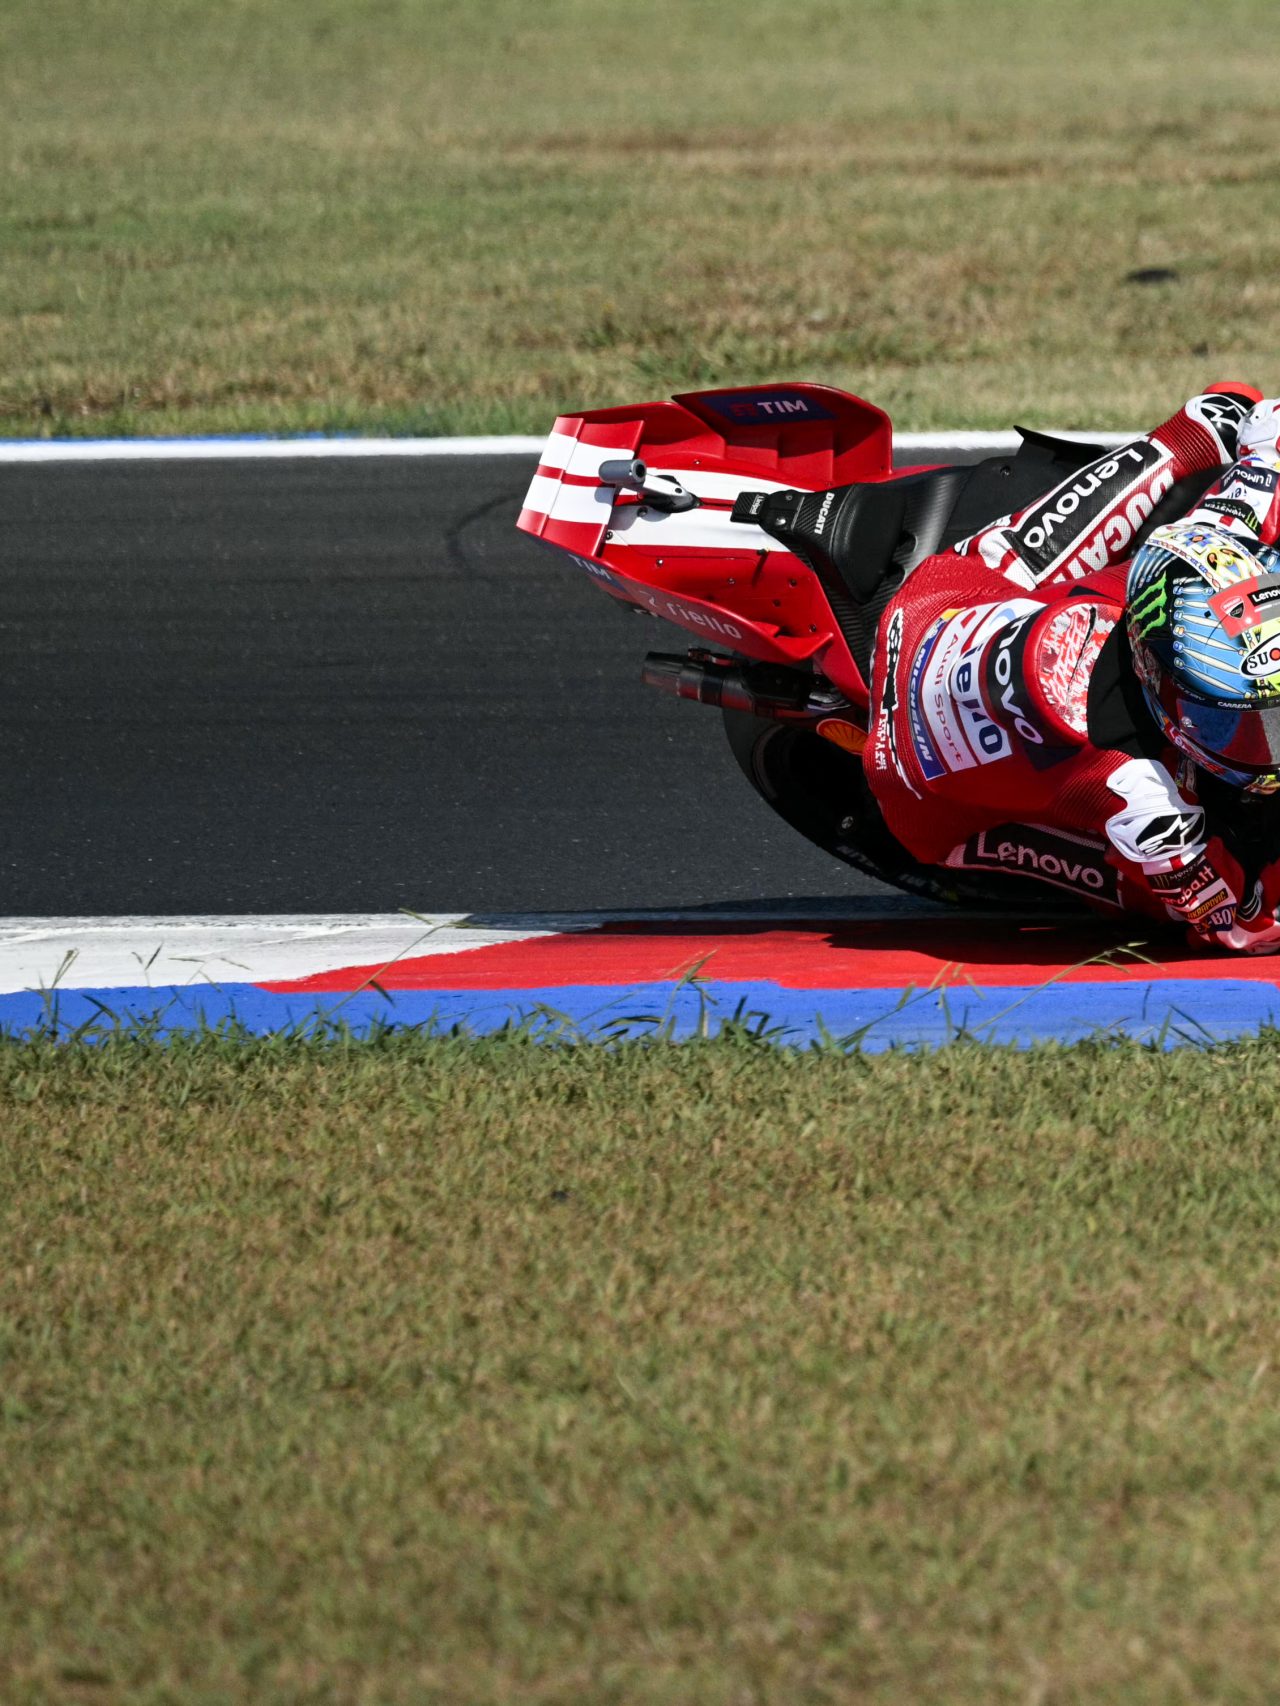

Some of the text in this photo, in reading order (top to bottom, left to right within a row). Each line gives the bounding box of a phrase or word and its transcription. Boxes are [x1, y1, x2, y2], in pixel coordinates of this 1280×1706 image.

[757, 399, 808, 414] TIM
[813, 492, 835, 535] DUCATI
[1024, 448, 1143, 548] Lenovo
[666, 602, 742, 640] riello
[908, 648, 934, 762] MICHELIN
[933, 632, 963, 764] Audi Sport
[1217, 701, 1252, 709] CARRERA
[976, 831, 1104, 888] Lenovo
